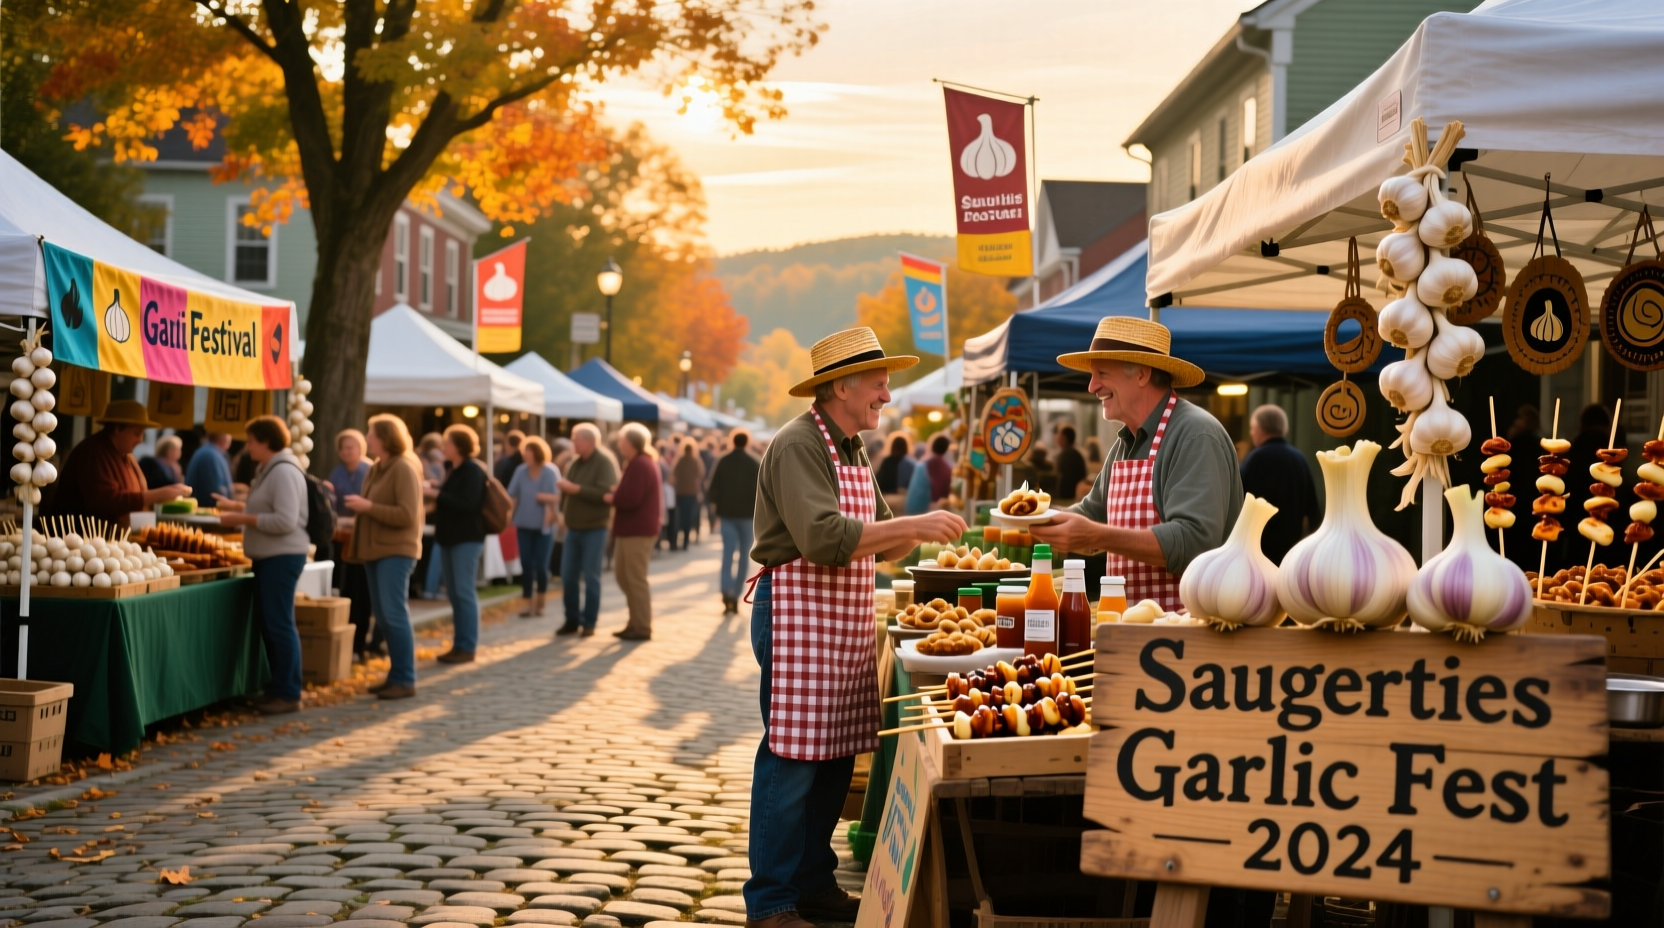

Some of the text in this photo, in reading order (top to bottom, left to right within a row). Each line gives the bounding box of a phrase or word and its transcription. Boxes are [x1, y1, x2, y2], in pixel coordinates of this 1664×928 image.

[190, 310, 257, 359] Festival
[1134, 637, 1553, 732] Saugerties
[1116, 727, 1570, 828] Garlic Fest
[1243, 817, 1422, 884] 2024
